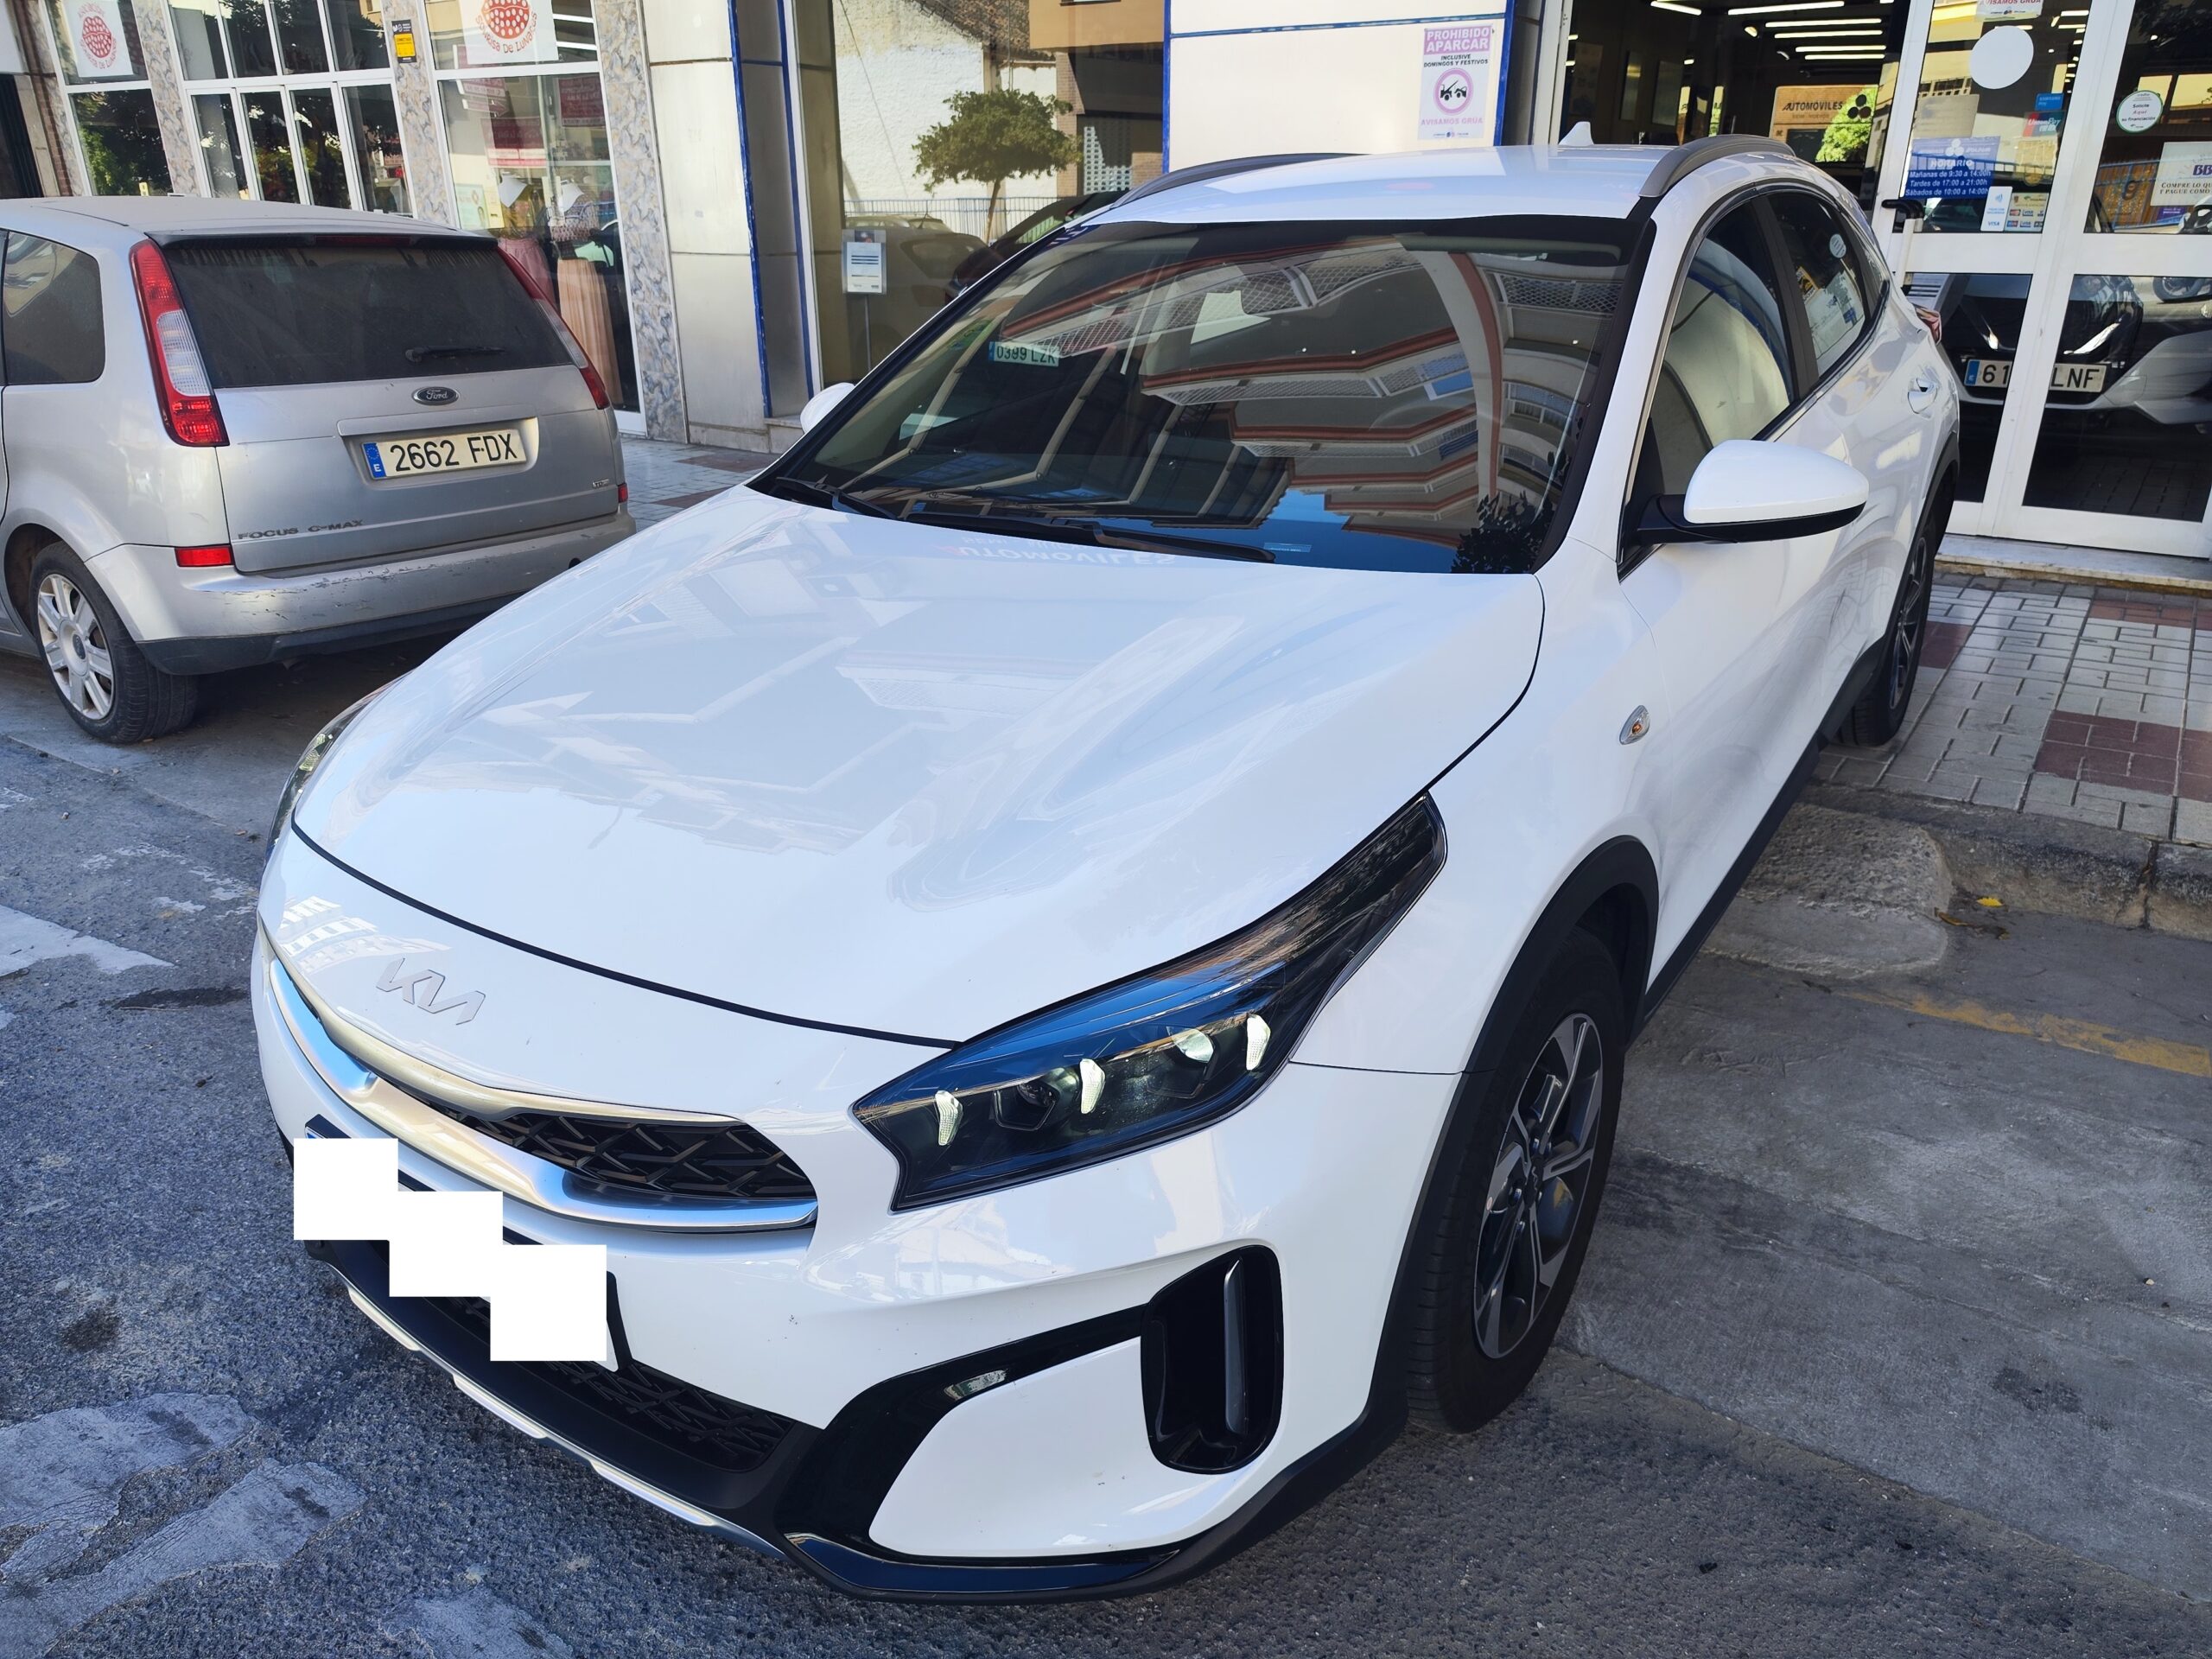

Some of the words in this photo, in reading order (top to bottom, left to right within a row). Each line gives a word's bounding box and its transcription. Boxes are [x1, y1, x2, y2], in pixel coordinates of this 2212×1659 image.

[1427, 27, 1490, 41] PROHIBIDO
[1426, 38, 1489, 53] APARCAR
[1423, 60, 1453, 68] DOMINGOS
[1930, 159, 1975, 168] HORARIO
[1970, 168, 1991, 177] 14:00h
[2050, 368, 2100, 388] LNF
[426, 390, 448, 400] Ford
[390, 439, 460, 473] 2662
[467, 433, 518, 464] FDX
[373, 463, 382, 473] E
[238, 526, 300, 540] FOCUS
[308, 519, 364, 532] C-MAX
[375, 957, 486, 1027] KIA
